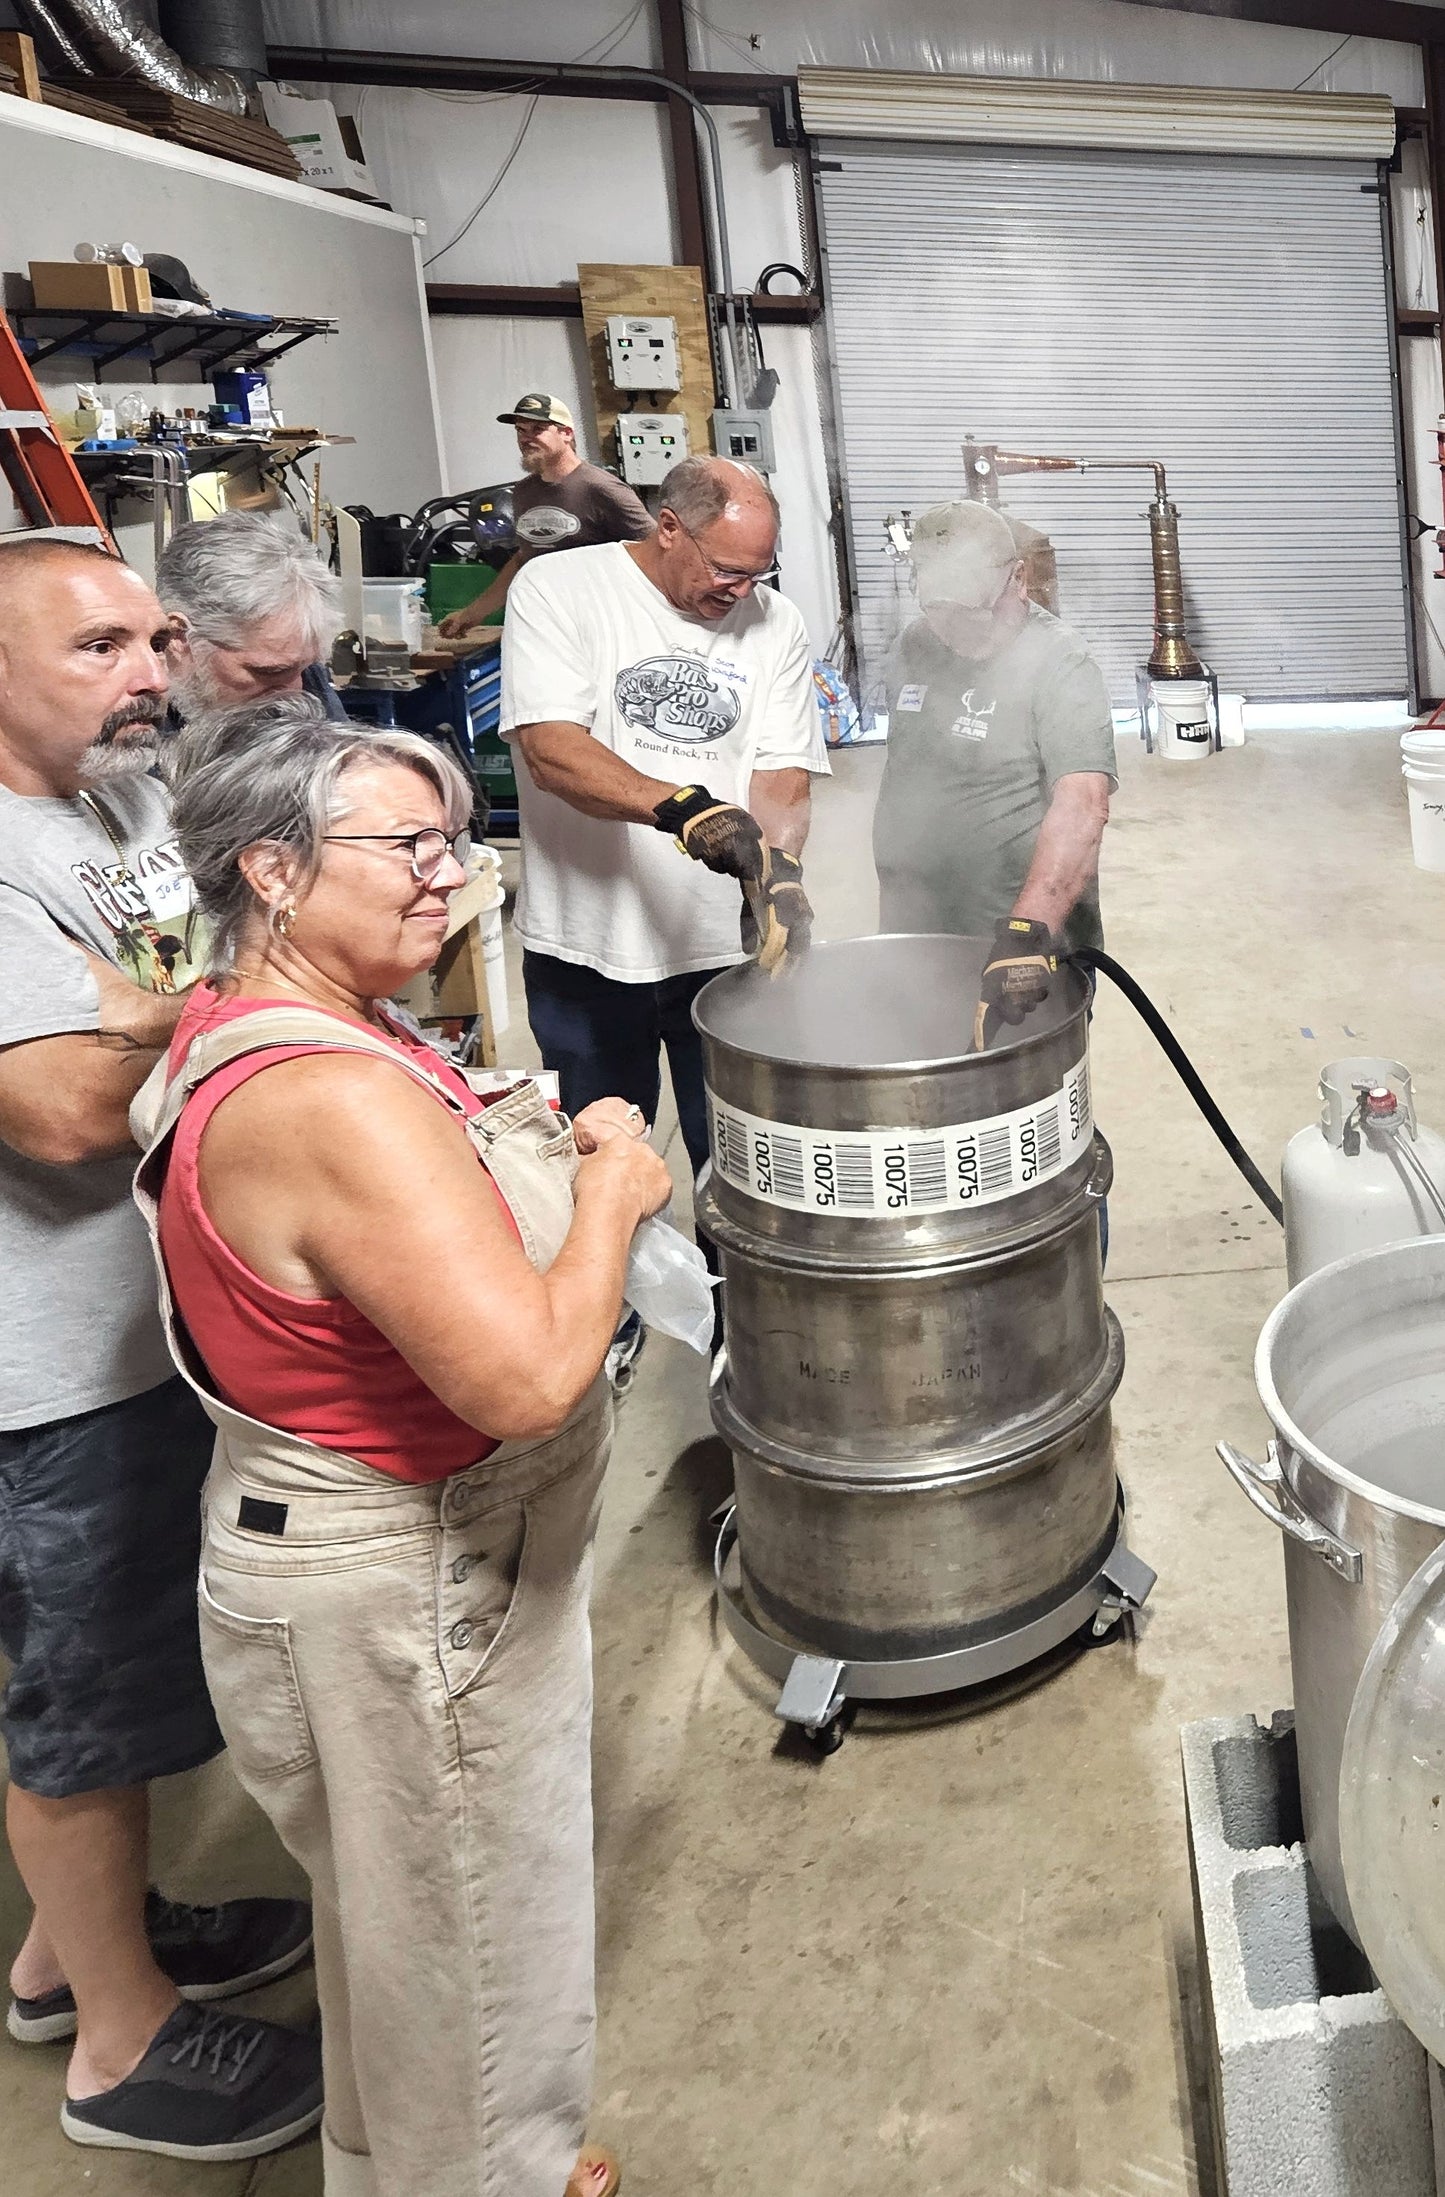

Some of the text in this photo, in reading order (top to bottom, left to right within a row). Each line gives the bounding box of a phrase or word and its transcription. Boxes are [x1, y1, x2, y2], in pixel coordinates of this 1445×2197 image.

[310, 167, 321, 176] 20
[664, 703, 732, 735] Shops
[667, 682, 709, 709] Pro
[634, 738, 719, 761] Round Rock, TX
[155, 879, 182, 900] JOE
[1067, 1078, 1081, 1142] 10075
[716, 1110, 730, 1175] 10075
[753, 1131, 773, 1195] 10075
[955, 1134, 979, 1200] 10075
[1018, 1116, 1038, 1182] 10075
[812, 1143, 836, 1206] 10075
[883, 1143, 908, 1209] 10075
